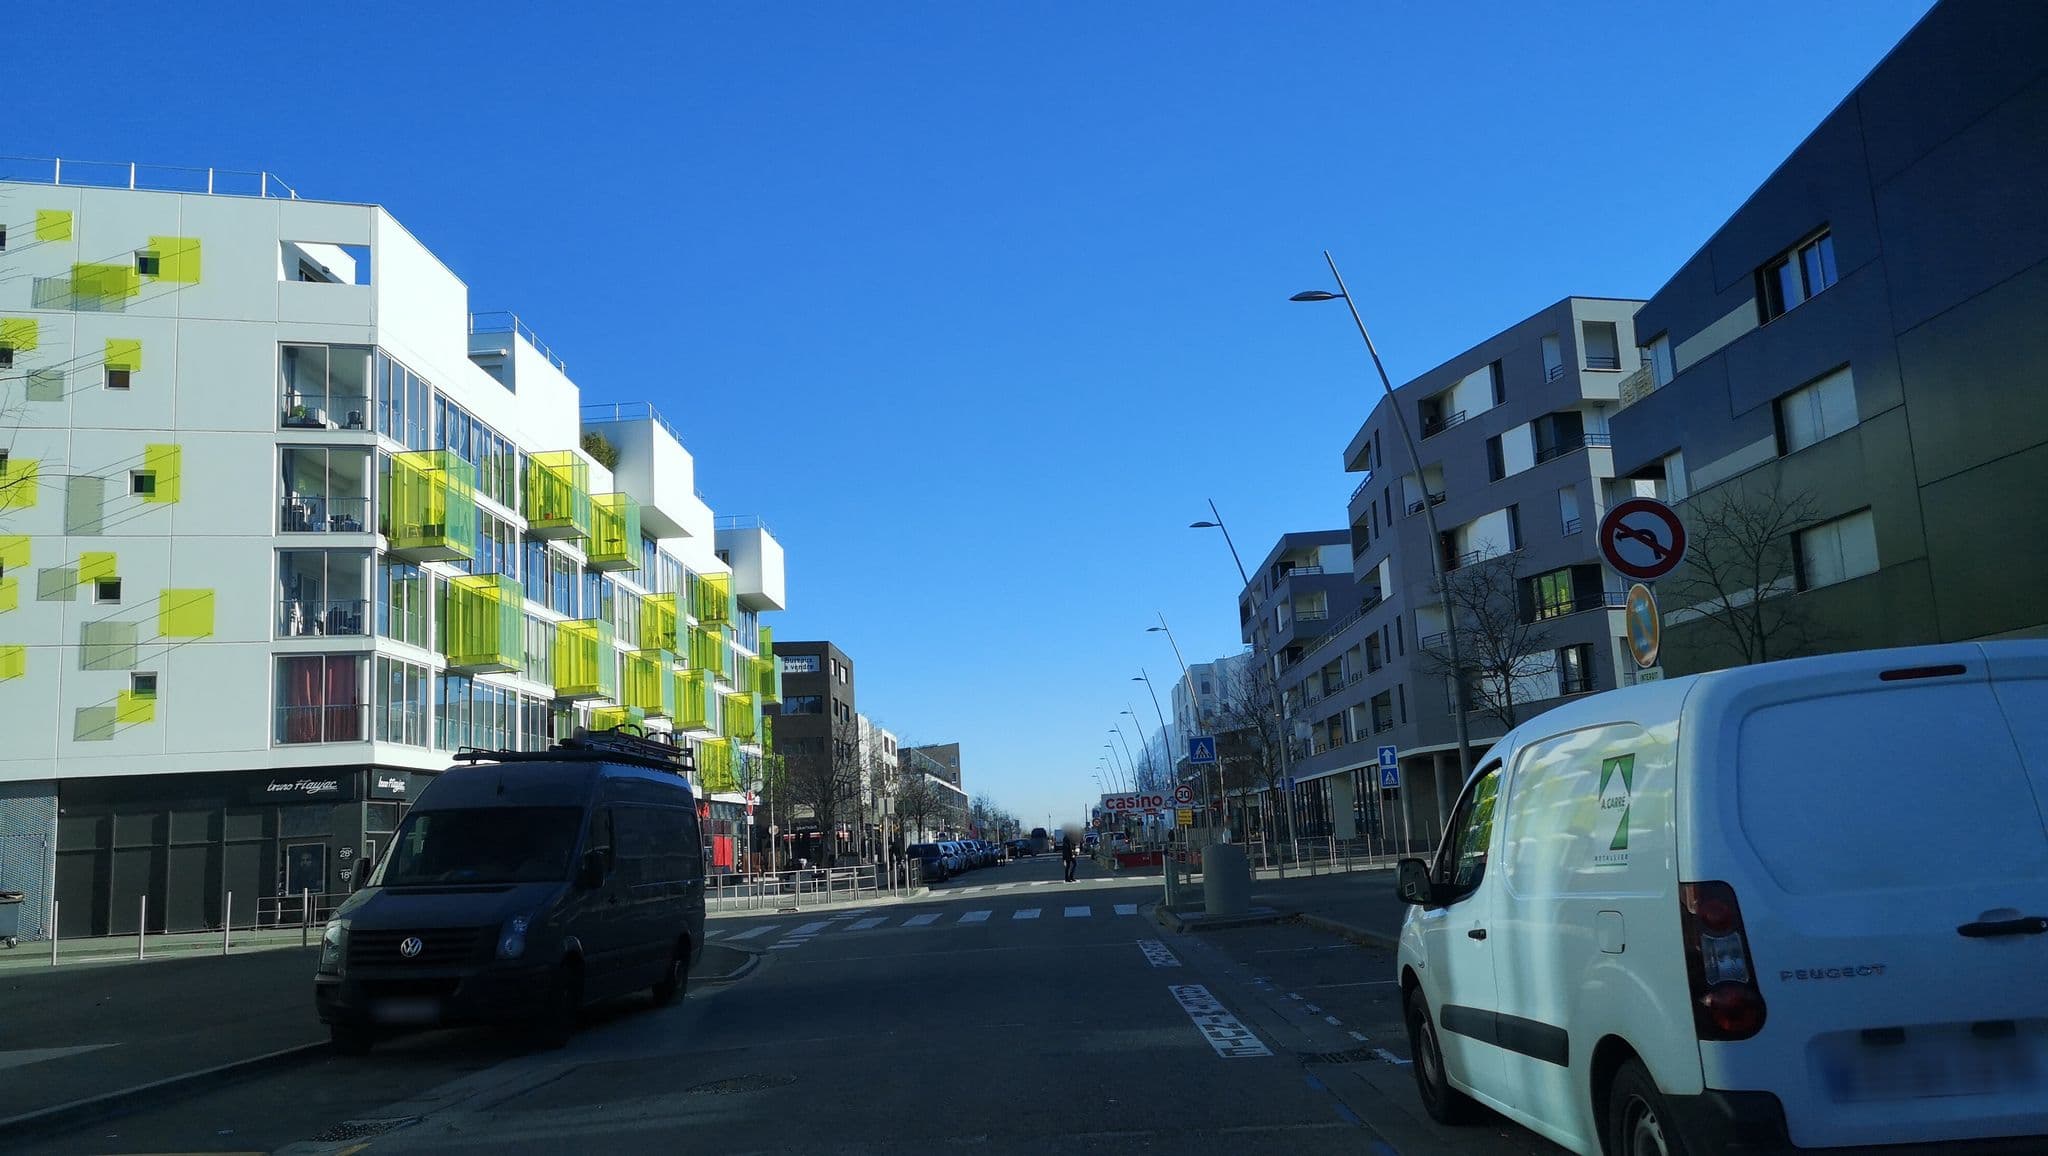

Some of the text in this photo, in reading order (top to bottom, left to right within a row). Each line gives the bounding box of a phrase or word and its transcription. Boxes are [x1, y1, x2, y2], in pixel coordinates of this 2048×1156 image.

[1105, 793, 1163, 810] casino
[1178, 790, 1190, 799] 30
[1780, 963, 1886, 982] PEUGEOT
